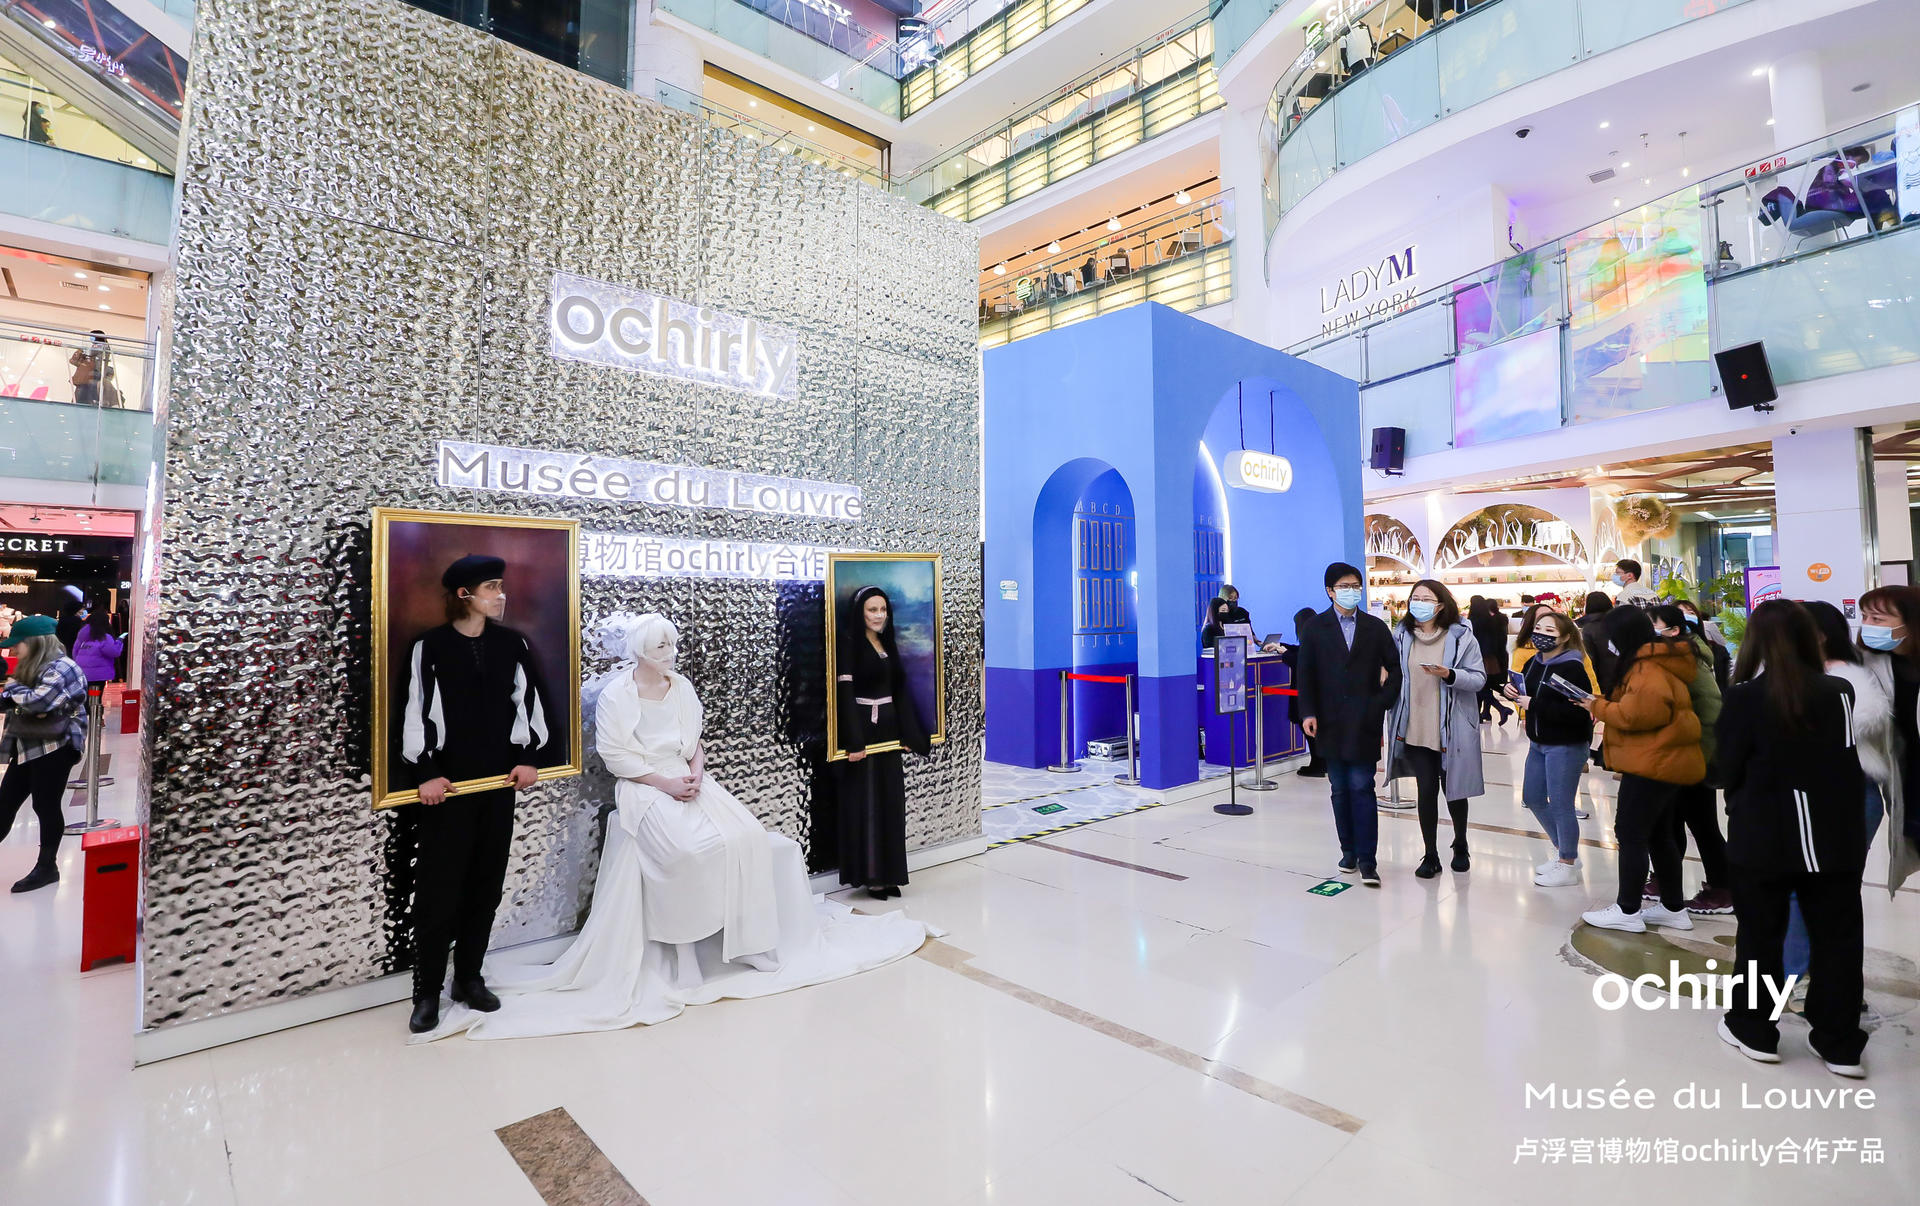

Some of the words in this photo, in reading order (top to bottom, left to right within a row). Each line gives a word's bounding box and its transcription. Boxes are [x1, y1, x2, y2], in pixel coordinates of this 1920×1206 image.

[1321, 310, 1359, 339] NEW
[1365, 286, 1417, 321] YORK
[555, 294, 796, 397] ochirly
[441, 446, 632, 500] Musée
[654, 471, 710, 507] du
[732, 477, 863, 519] Louvre
[1244, 458, 1288, 487] ochirly
